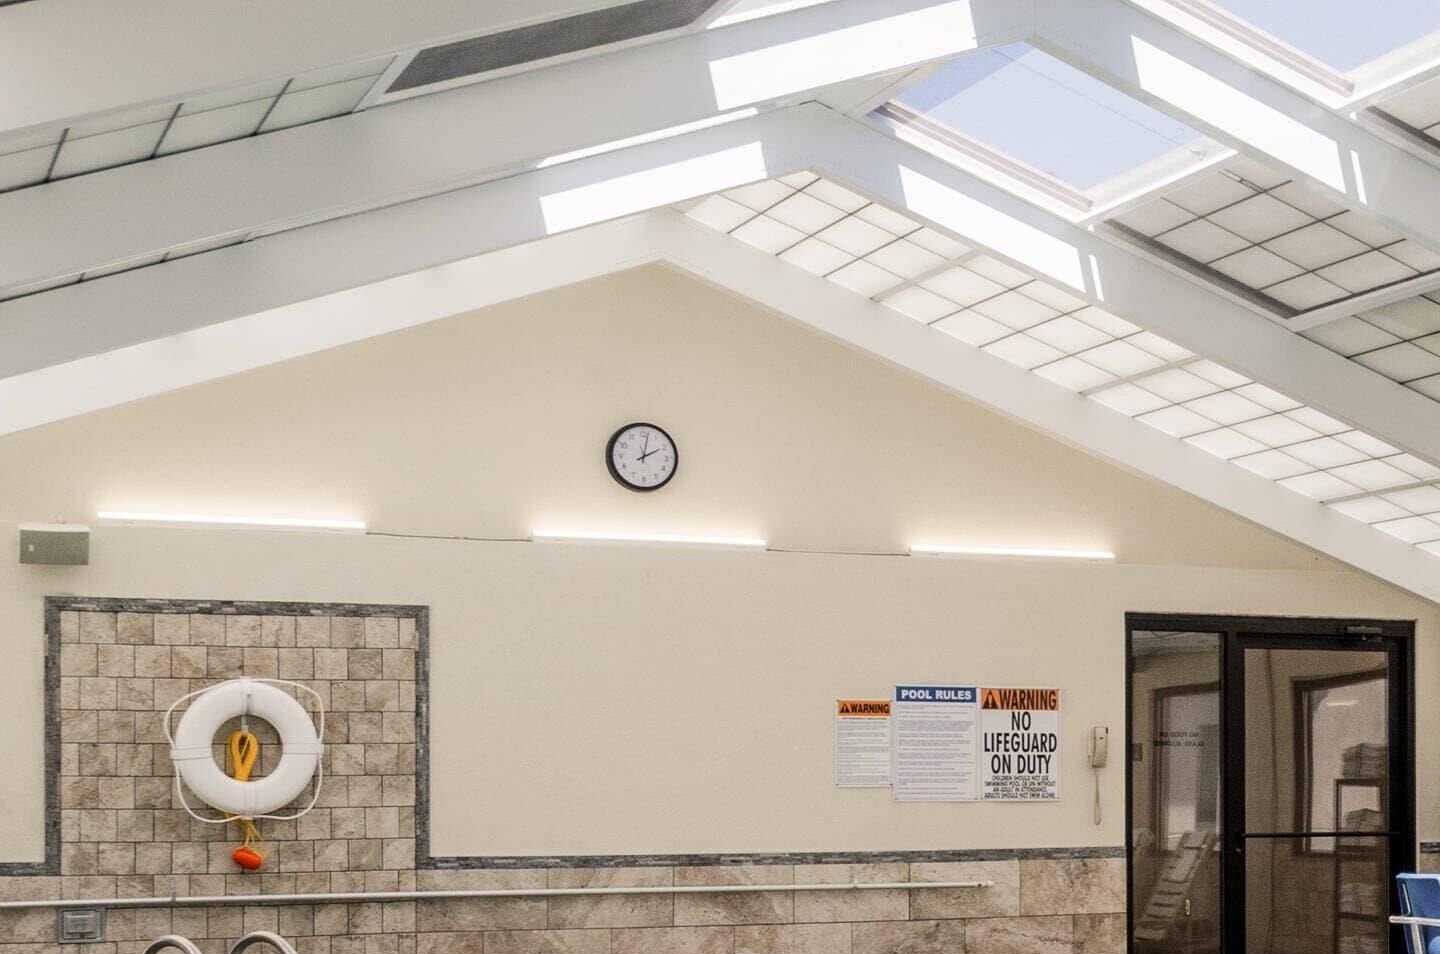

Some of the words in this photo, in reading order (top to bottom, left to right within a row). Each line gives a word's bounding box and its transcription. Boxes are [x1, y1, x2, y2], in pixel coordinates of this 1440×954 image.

[901, 690, 932, 699] POOL
[935, 690, 972, 700] RULES
[999, 690, 1057, 710] WARNING
[850, 703, 890, 714] WARNING
[1011, 711, 1031, 731] NO
[984, 732, 1057, 753] LIFEGUARD
[991, 754, 1012, 774] ON
[1017, 754, 1051, 774] DUTY
